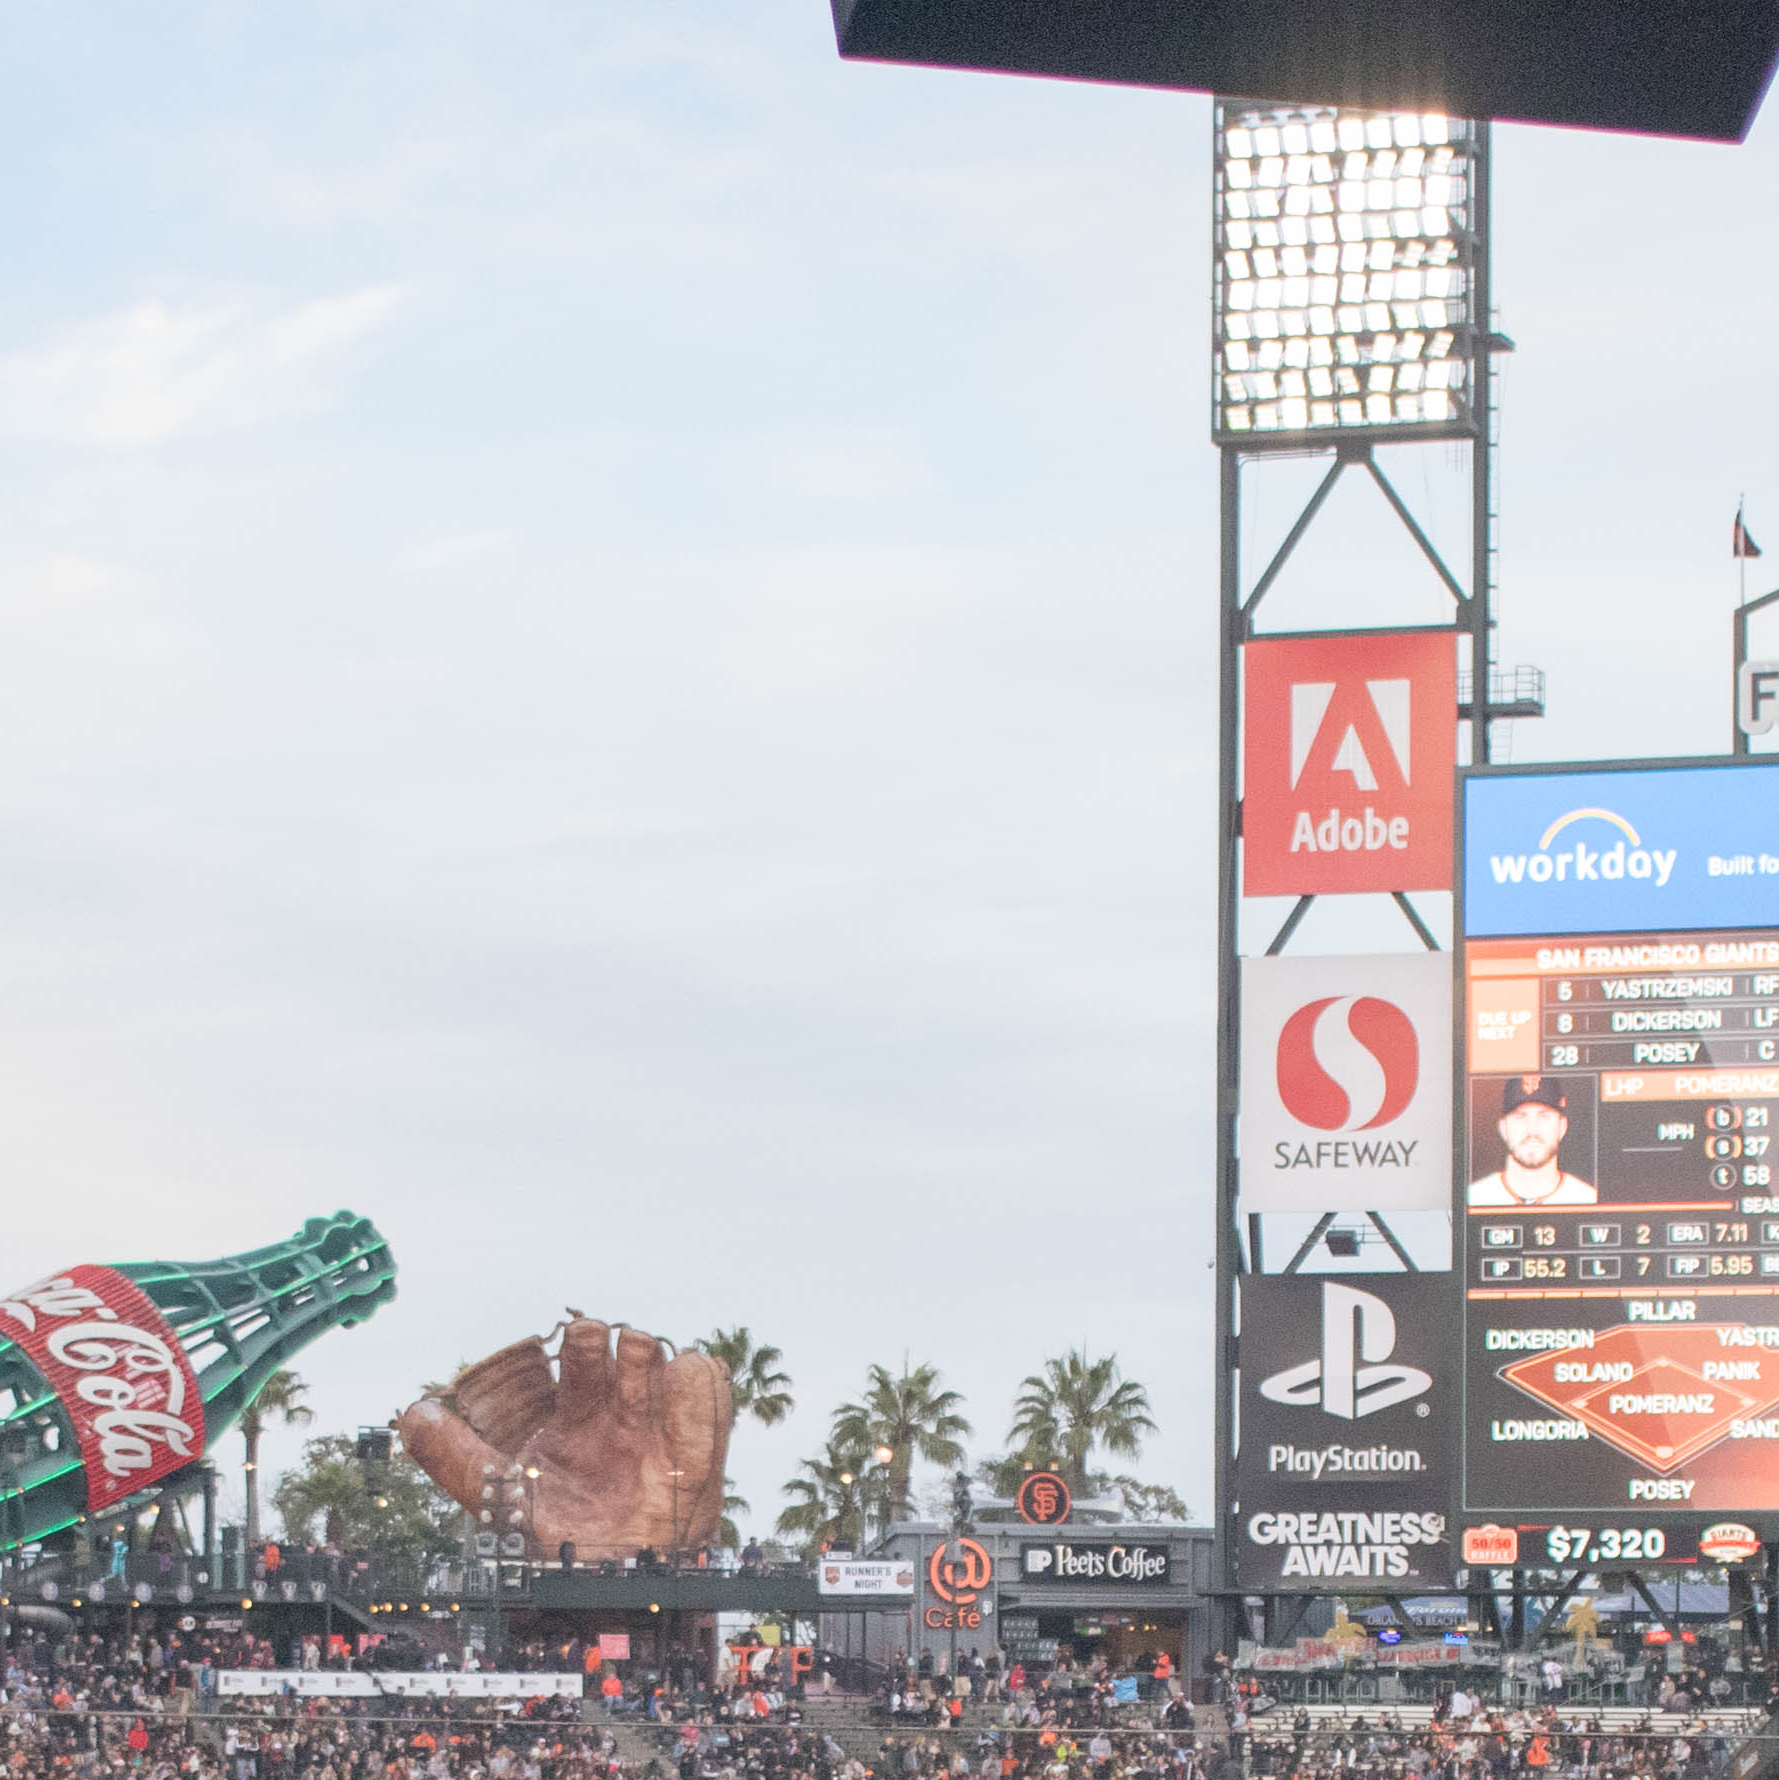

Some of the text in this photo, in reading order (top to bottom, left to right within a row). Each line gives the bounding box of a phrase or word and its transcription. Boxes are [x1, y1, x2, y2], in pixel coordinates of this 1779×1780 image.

[1290, 807, 1410, 853] Adobe
[1490, 841, 1678, 887] workday
[1708, 853, 1755, 876] Built
[1536, 943, 1779, 969] SAN FRANCISCO GIANTS
[1557, 981, 1572, 1001] 5
[1601, 977, 1733, 999] YASTRZEMSKI
[1754, 975, 1779, 995] RF
[1557, 1007, 1779, 1034] 8 DICKERSON LF
[1551, 1046, 1579, 1066] 28
[1634, 1043, 1700, 1064] POSEY
[1758, 1040, 1775, 1060] C
[1605, 1076, 1643, 1096] LHP
[1675, 1073, 1779, 1094] POMERANZ
[1274, 1140, 1420, 1169] SAFEWAY
[1534, 1226, 1556, 1246] 13
[1671, 1226, 1704, 1243] ERA
[1715, 1223, 1749, 1243] 7.11
[1524, 1258, 1566, 1278] 55.2
[1710, 1256, 1753, 1276] 5.95
[1629, 1301, 1696, 1321] PILLAR
[1486, 1329, 1595, 1351] DICKERSON
[1554, 1361, 1761, 1383] SOLANO PANIK
[1609, 1395, 1715, 1415] POMERANZ
[1492, 1420, 1589, 1441] LONGORIA
[1269, 1445, 1422, 1479] PlayStation
[1629, 1479, 1696, 1500] POSEY
[1248, 1512, 1446, 1544] GREATNESS
[1547, 1526, 1666, 1563] $7,320
[844, 1566, 893, 1578] RUNNER'S
[1056, 1545, 1167, 1582] Peet's Coffee
[1282, 1545, 1409, 1576] AWAITS
[854, 1578, 884, 1590] NIGHT
[925, 1605, 982, 1629] Café
